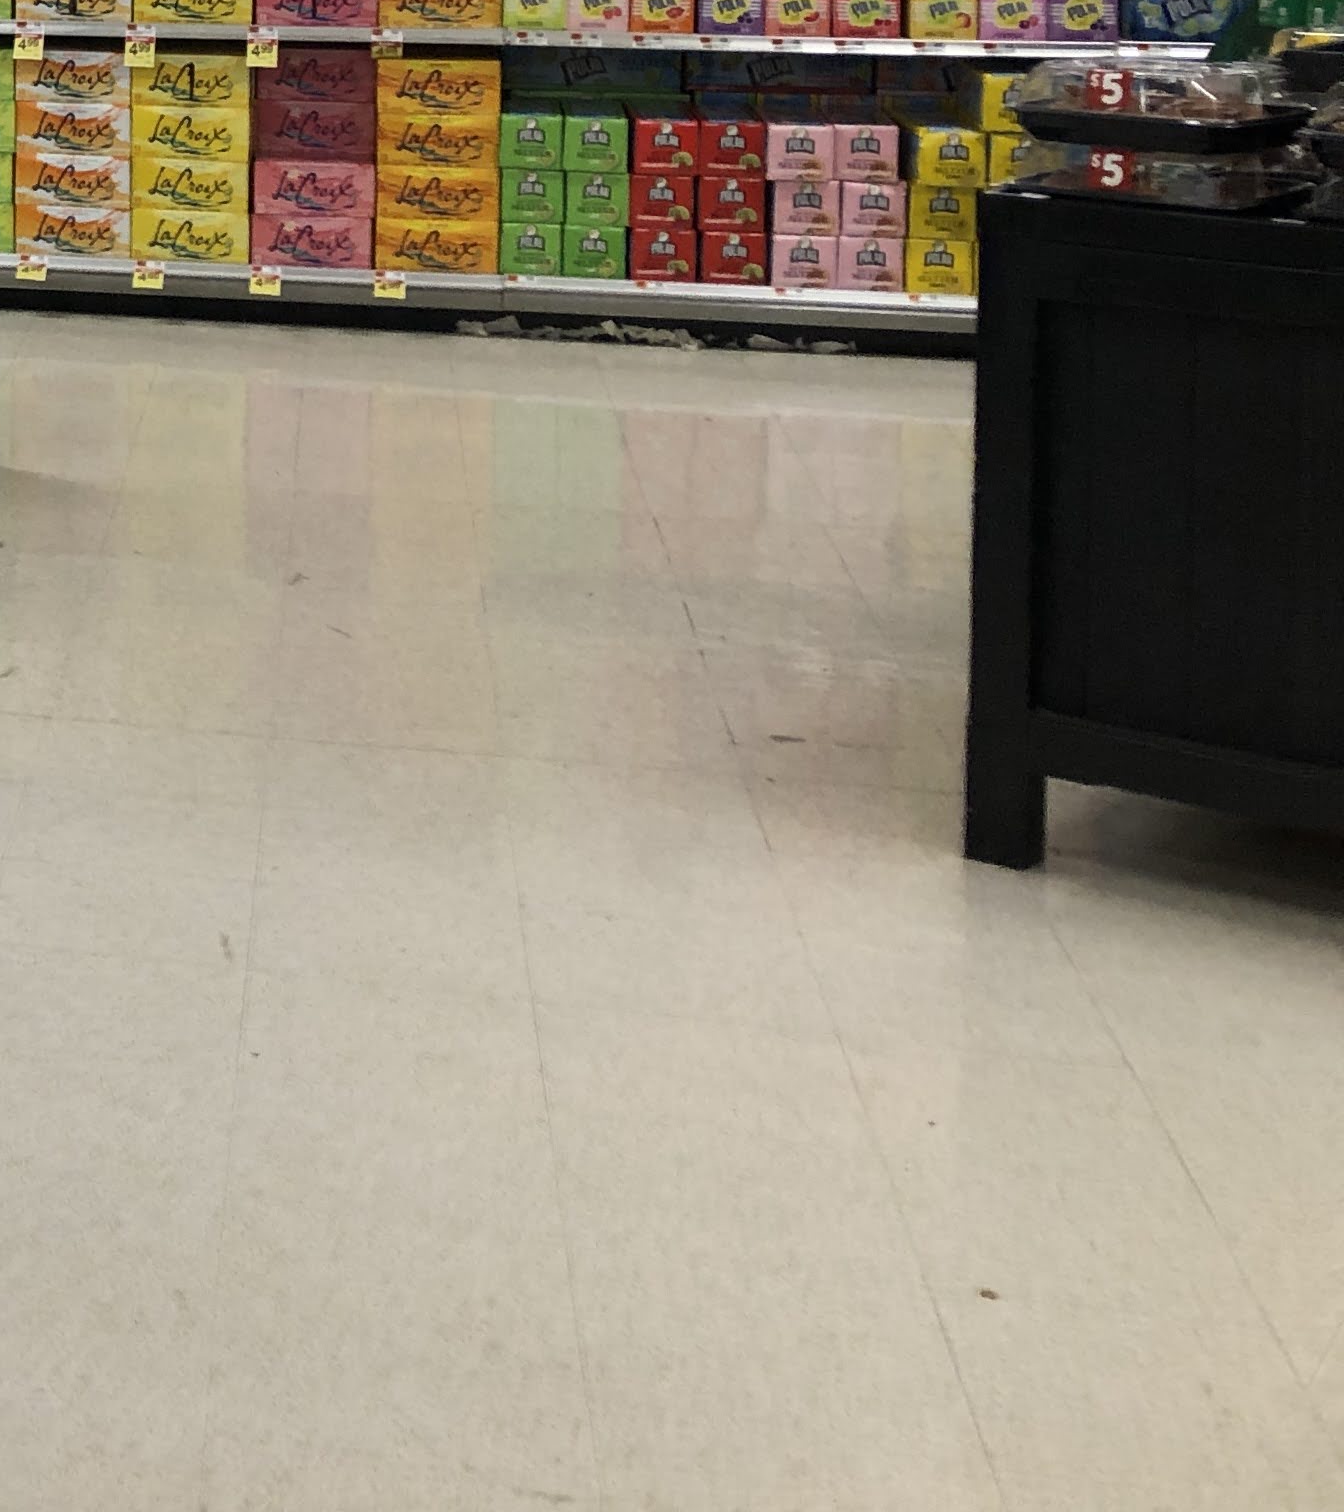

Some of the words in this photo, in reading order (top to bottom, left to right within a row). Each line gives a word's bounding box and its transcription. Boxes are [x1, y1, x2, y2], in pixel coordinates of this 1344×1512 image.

[33, 60, 107, 87] LaCroix
[397, 70, 477, 97] LaCroix
[1090, 72, 1125, 106] $5
[33, 113, 109, 139] LaCroix
[150, 116, 226, 144] LaCroix
[397, 125, 476, 153] LaCroix
[33, 165, 109, 192] LaCroix
[1090, 153, 1125, 187] $5
[149, 170, 226, 198] LaCroix
[275, 173, 352, 200] LaCroix
[397, 176, 476, 206] LaCroix
[34, 216, 109, 243] LaCroix
[150, 221, 226, 247] LaCroix
[272, 224, 350, 251] LaCroix
[397, 230, 476, 258] LaCroix
